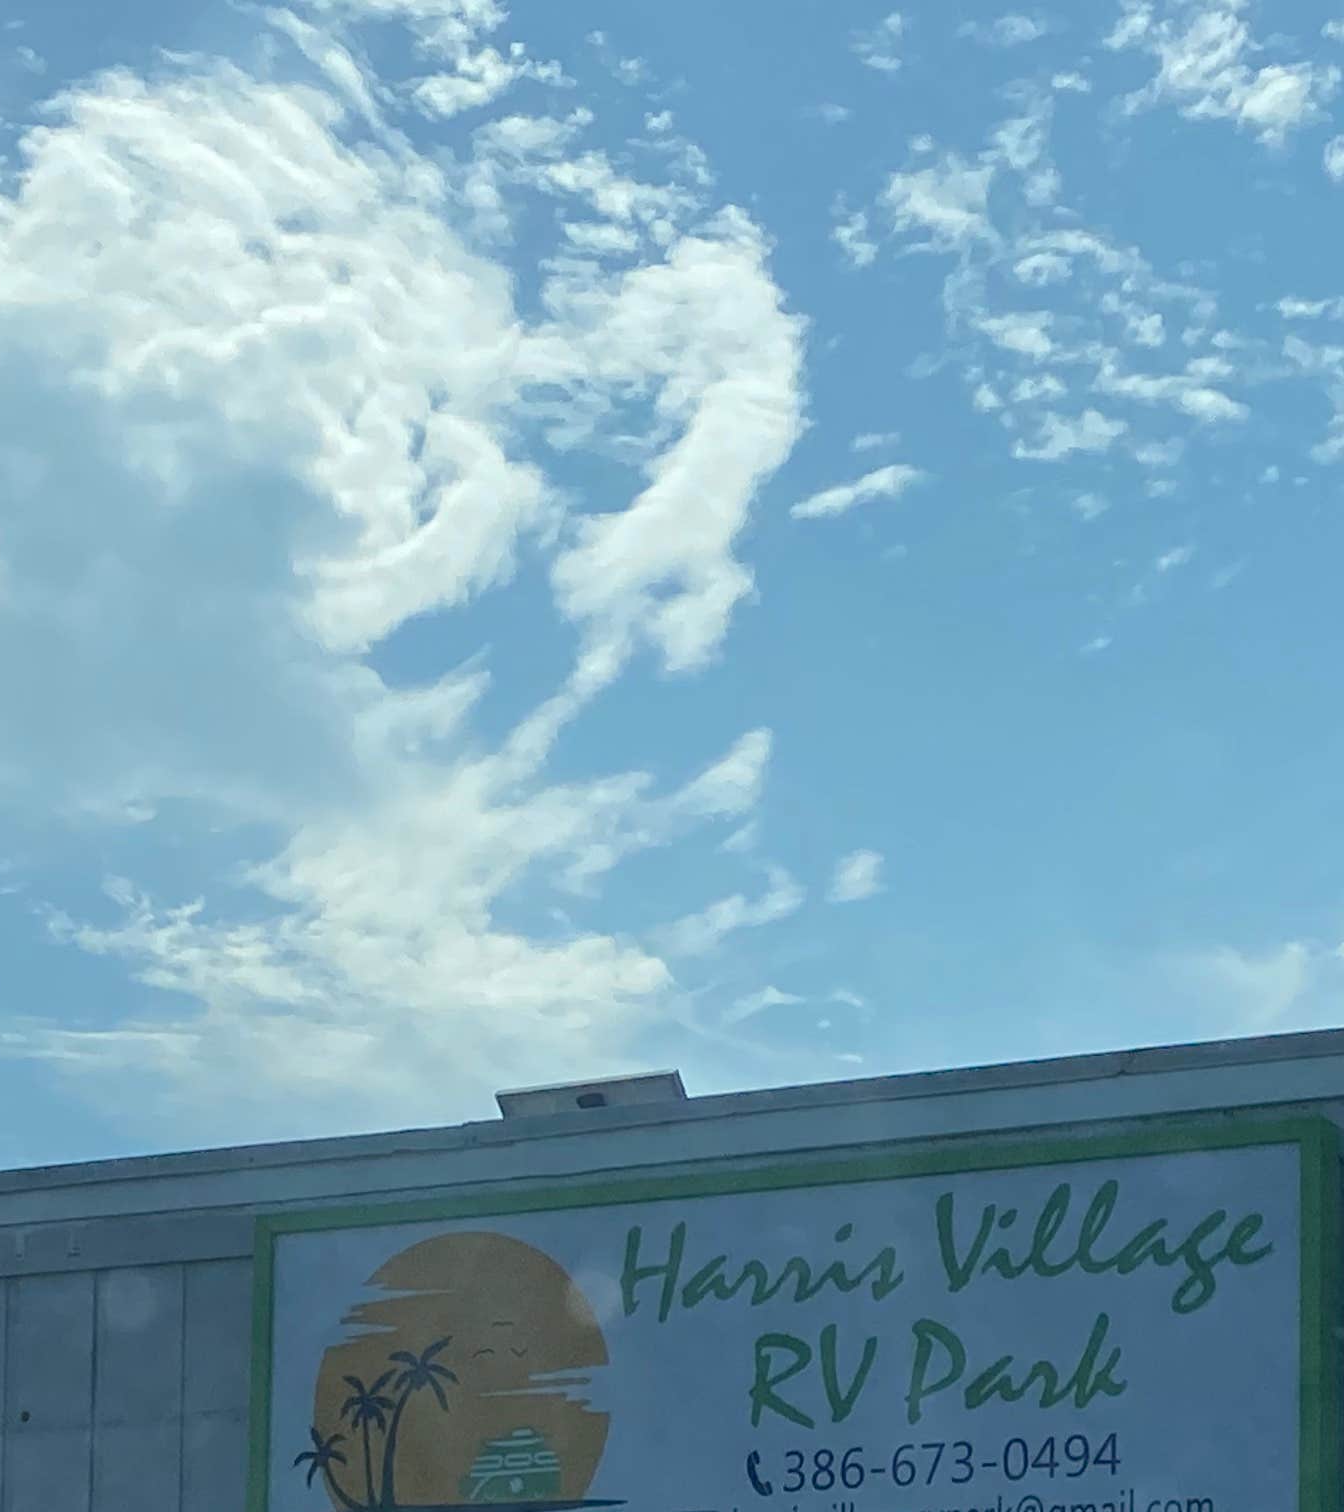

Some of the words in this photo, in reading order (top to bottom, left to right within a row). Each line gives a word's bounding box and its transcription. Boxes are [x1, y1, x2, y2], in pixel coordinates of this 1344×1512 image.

[620, 1221, 904, 1323] Harris
[935, 1179, 1273, 1314] Village
[749, 1322, 877, 1430] RV
[904, 1312, 1127, 1425] Park
[782, 1432, 1121, 1494] 386-673-0494
